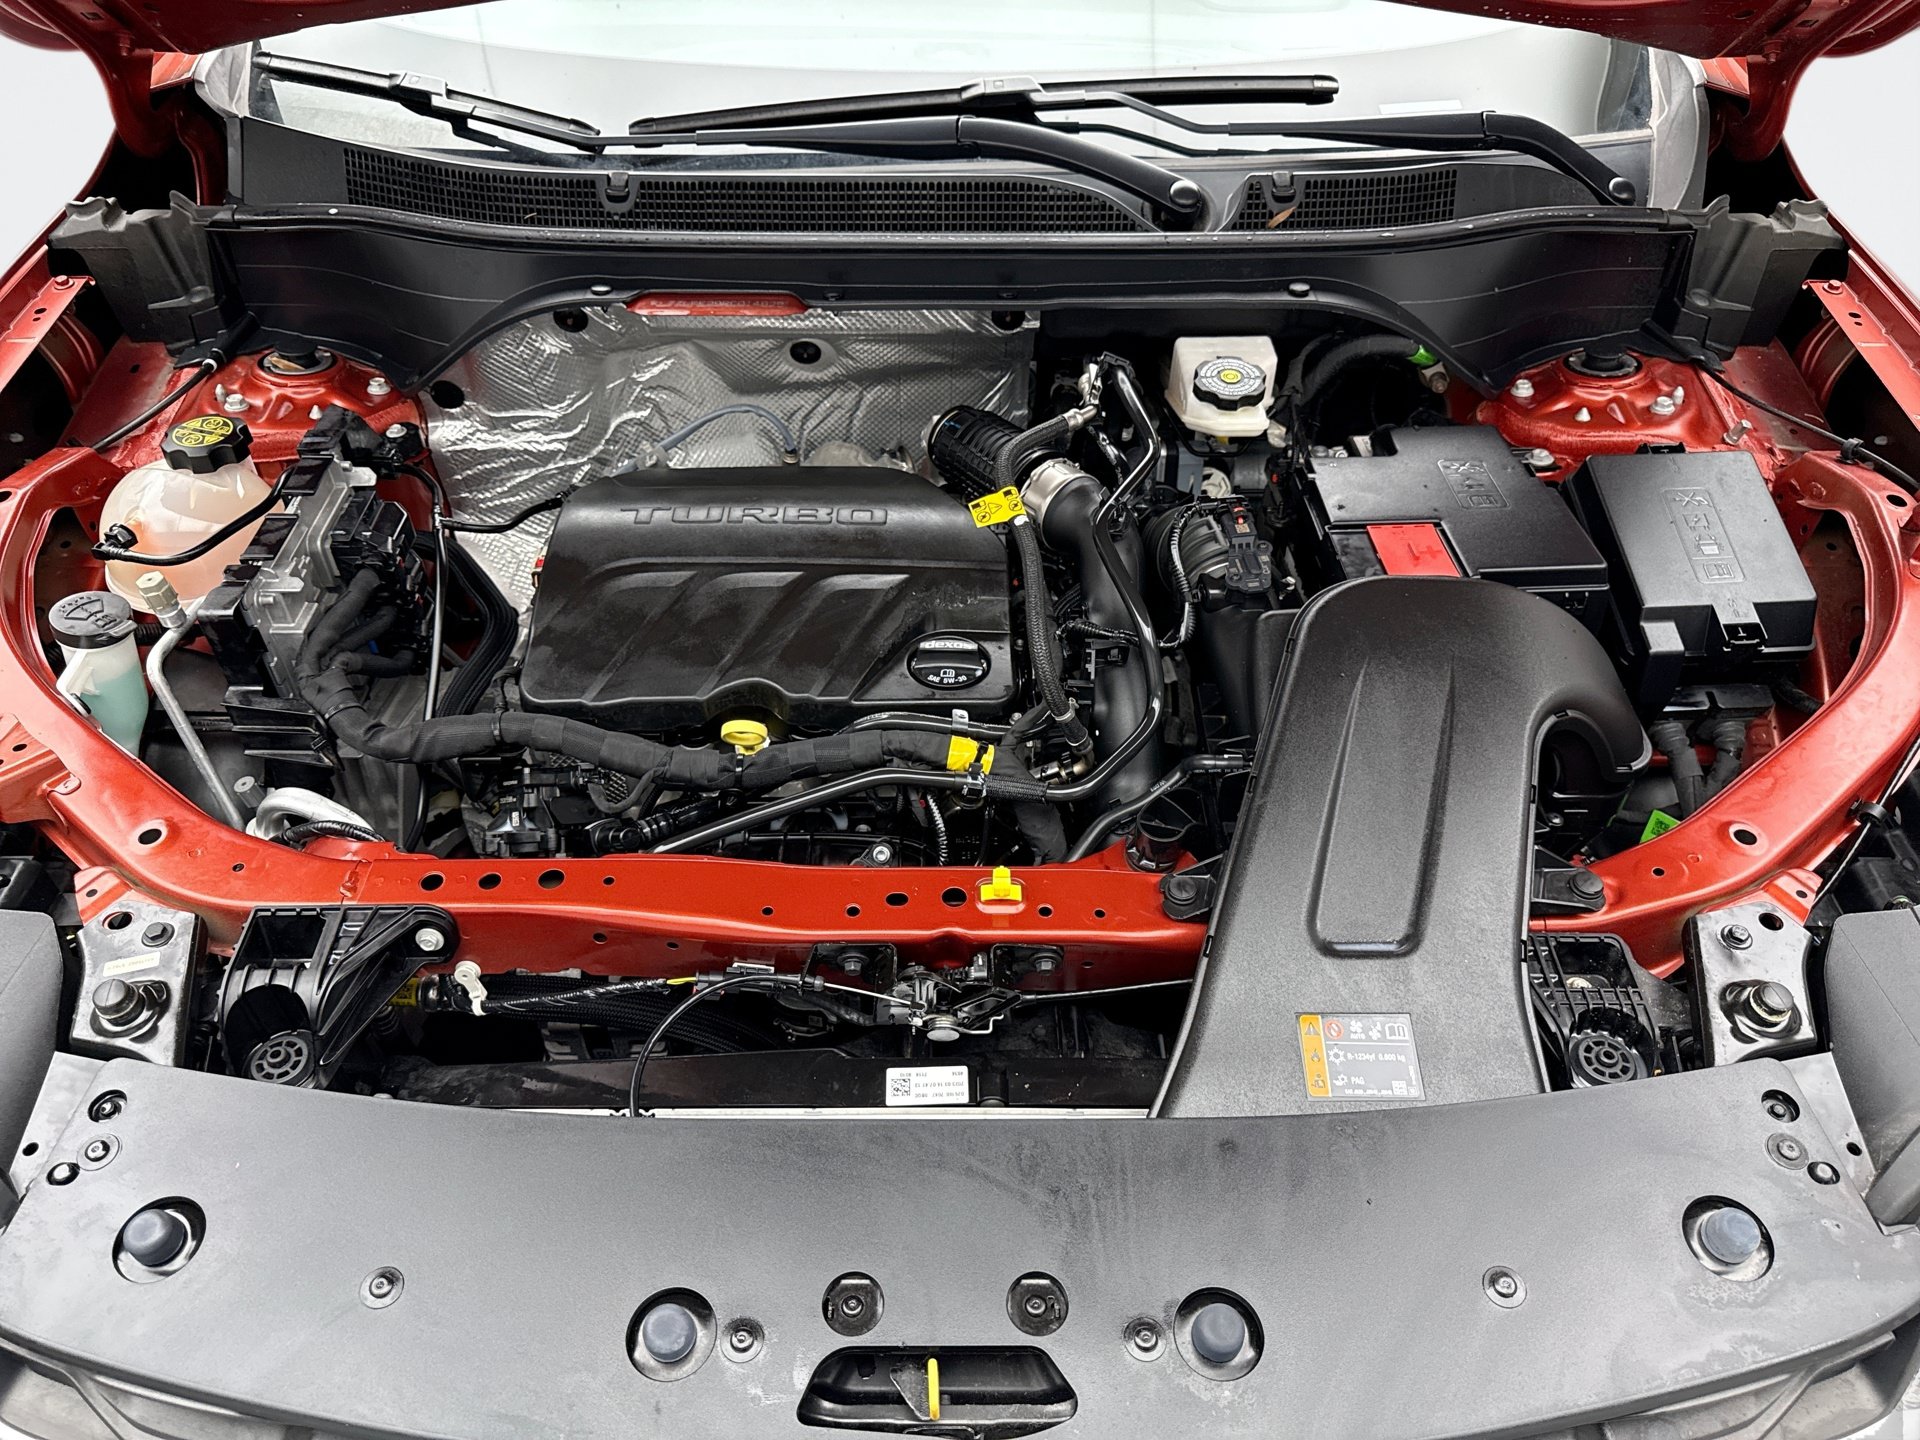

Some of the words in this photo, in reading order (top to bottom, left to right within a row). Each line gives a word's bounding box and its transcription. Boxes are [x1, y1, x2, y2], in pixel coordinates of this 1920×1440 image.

[620, 505, 888, 527] TURBO
[924, 640, 976, 651] dexos
[927, 674, 942, 683] SAE
[943, 675, 968, 684] 5W-30
[1350, 1075, 1365, 1085] PAG
